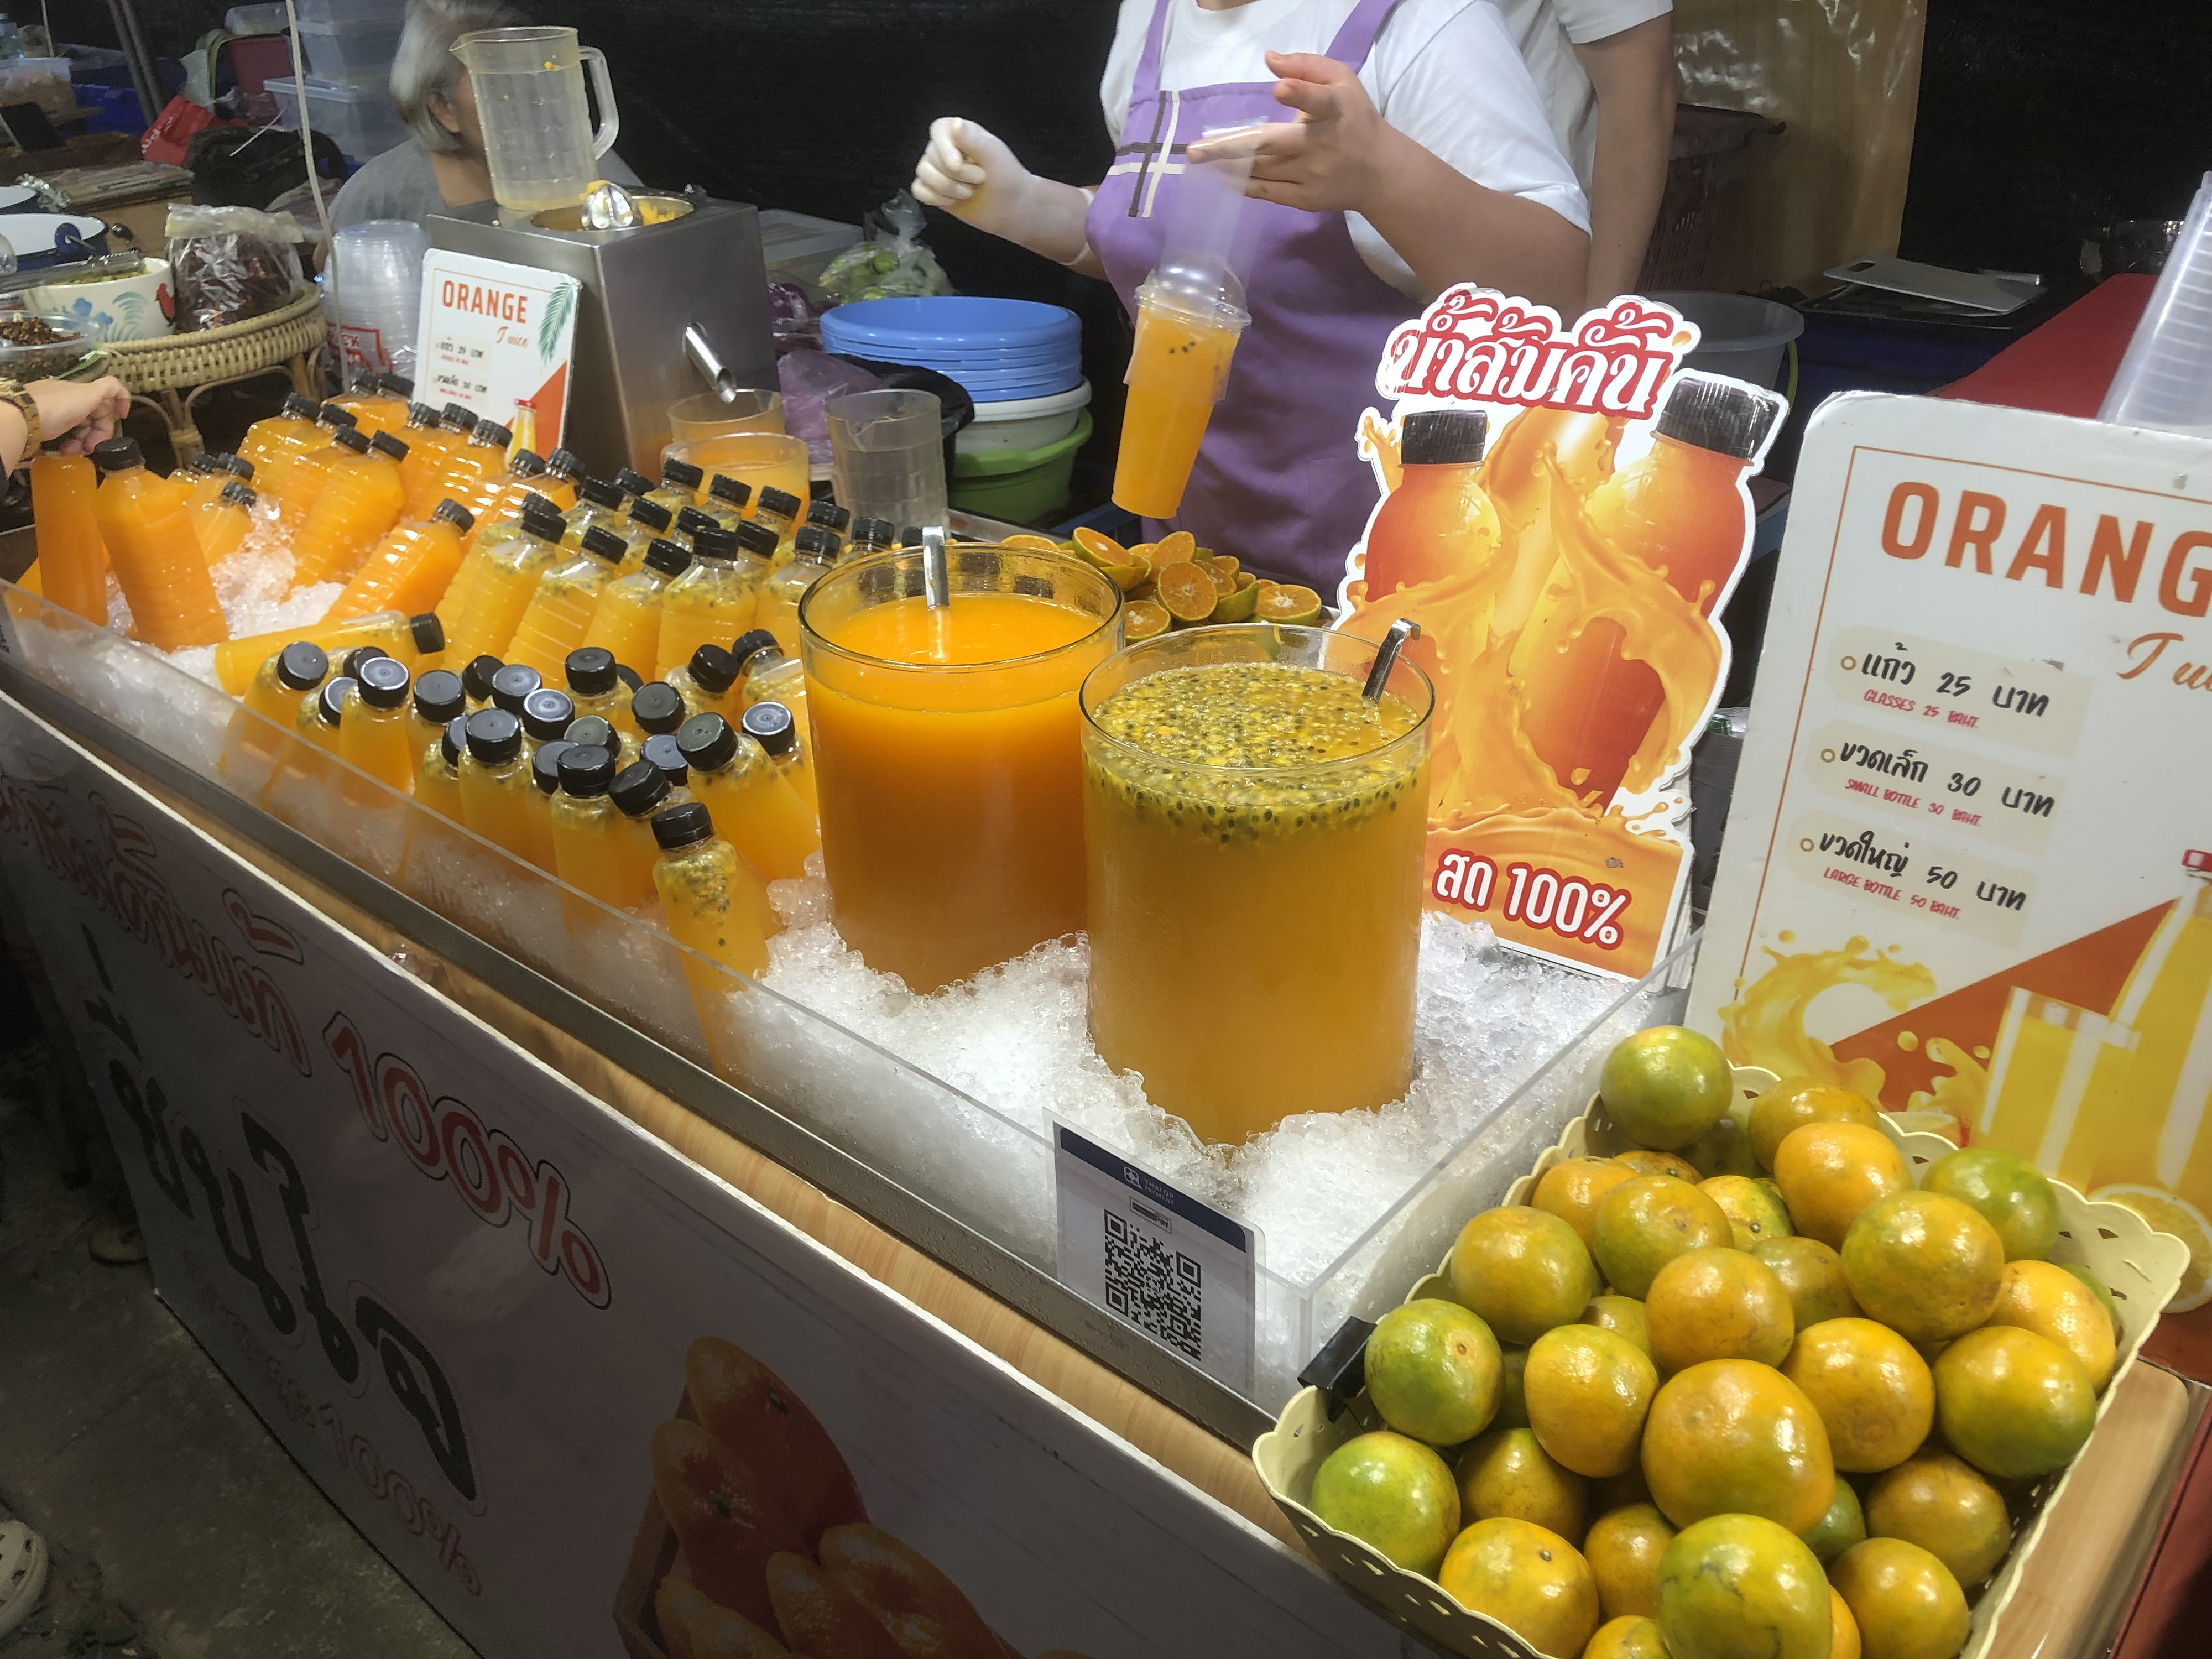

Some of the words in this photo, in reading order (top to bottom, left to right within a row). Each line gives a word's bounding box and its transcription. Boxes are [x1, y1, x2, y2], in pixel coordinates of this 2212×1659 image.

[442, 280, 528, 324] ORANGE
[1387, 290, 1672, 418] น้ำส้มคั้น
[1861, 641, 1916, 685] แก้ว
[1936, 672, 1971, 697] 25
[1992, 685, 2049, 717] บาท
[1864, 689, 1916, 712] GLASSES
[1923, 705, 1940, 718] 25
[1947, 710, 1980, 729] BAHT.
[1840, 742, 1929, 783] ขวดเล็ก
[1947, 773, 1981, 797] 30
[2001, 787, 2056, 818] บาท
[1844, 779, 1879, 798] SMALL
[1883, 789, 1921, 808] BOTTLE
[1928, 802, 1944, 815] 30
[1952, 808, 1982, 827] BAHT.
[1434, 851, 1495, 909] สด
[1506, 865, 1629, 947] 100%
[1819, 830, 1910, 878] ขวดใหญ่
[1926, 866, 1958, 889] 50
[1976, 881, 2027, 911] บาท
[1824, 867, 1862, 888] LARGE
[1863, 879, 1902, 901] BOTTLE
[1910, 895, 1927, 908] 50
[1929, 901, 1961, 919] BAHT.
[327, 1019, 607, 1303] 100%
